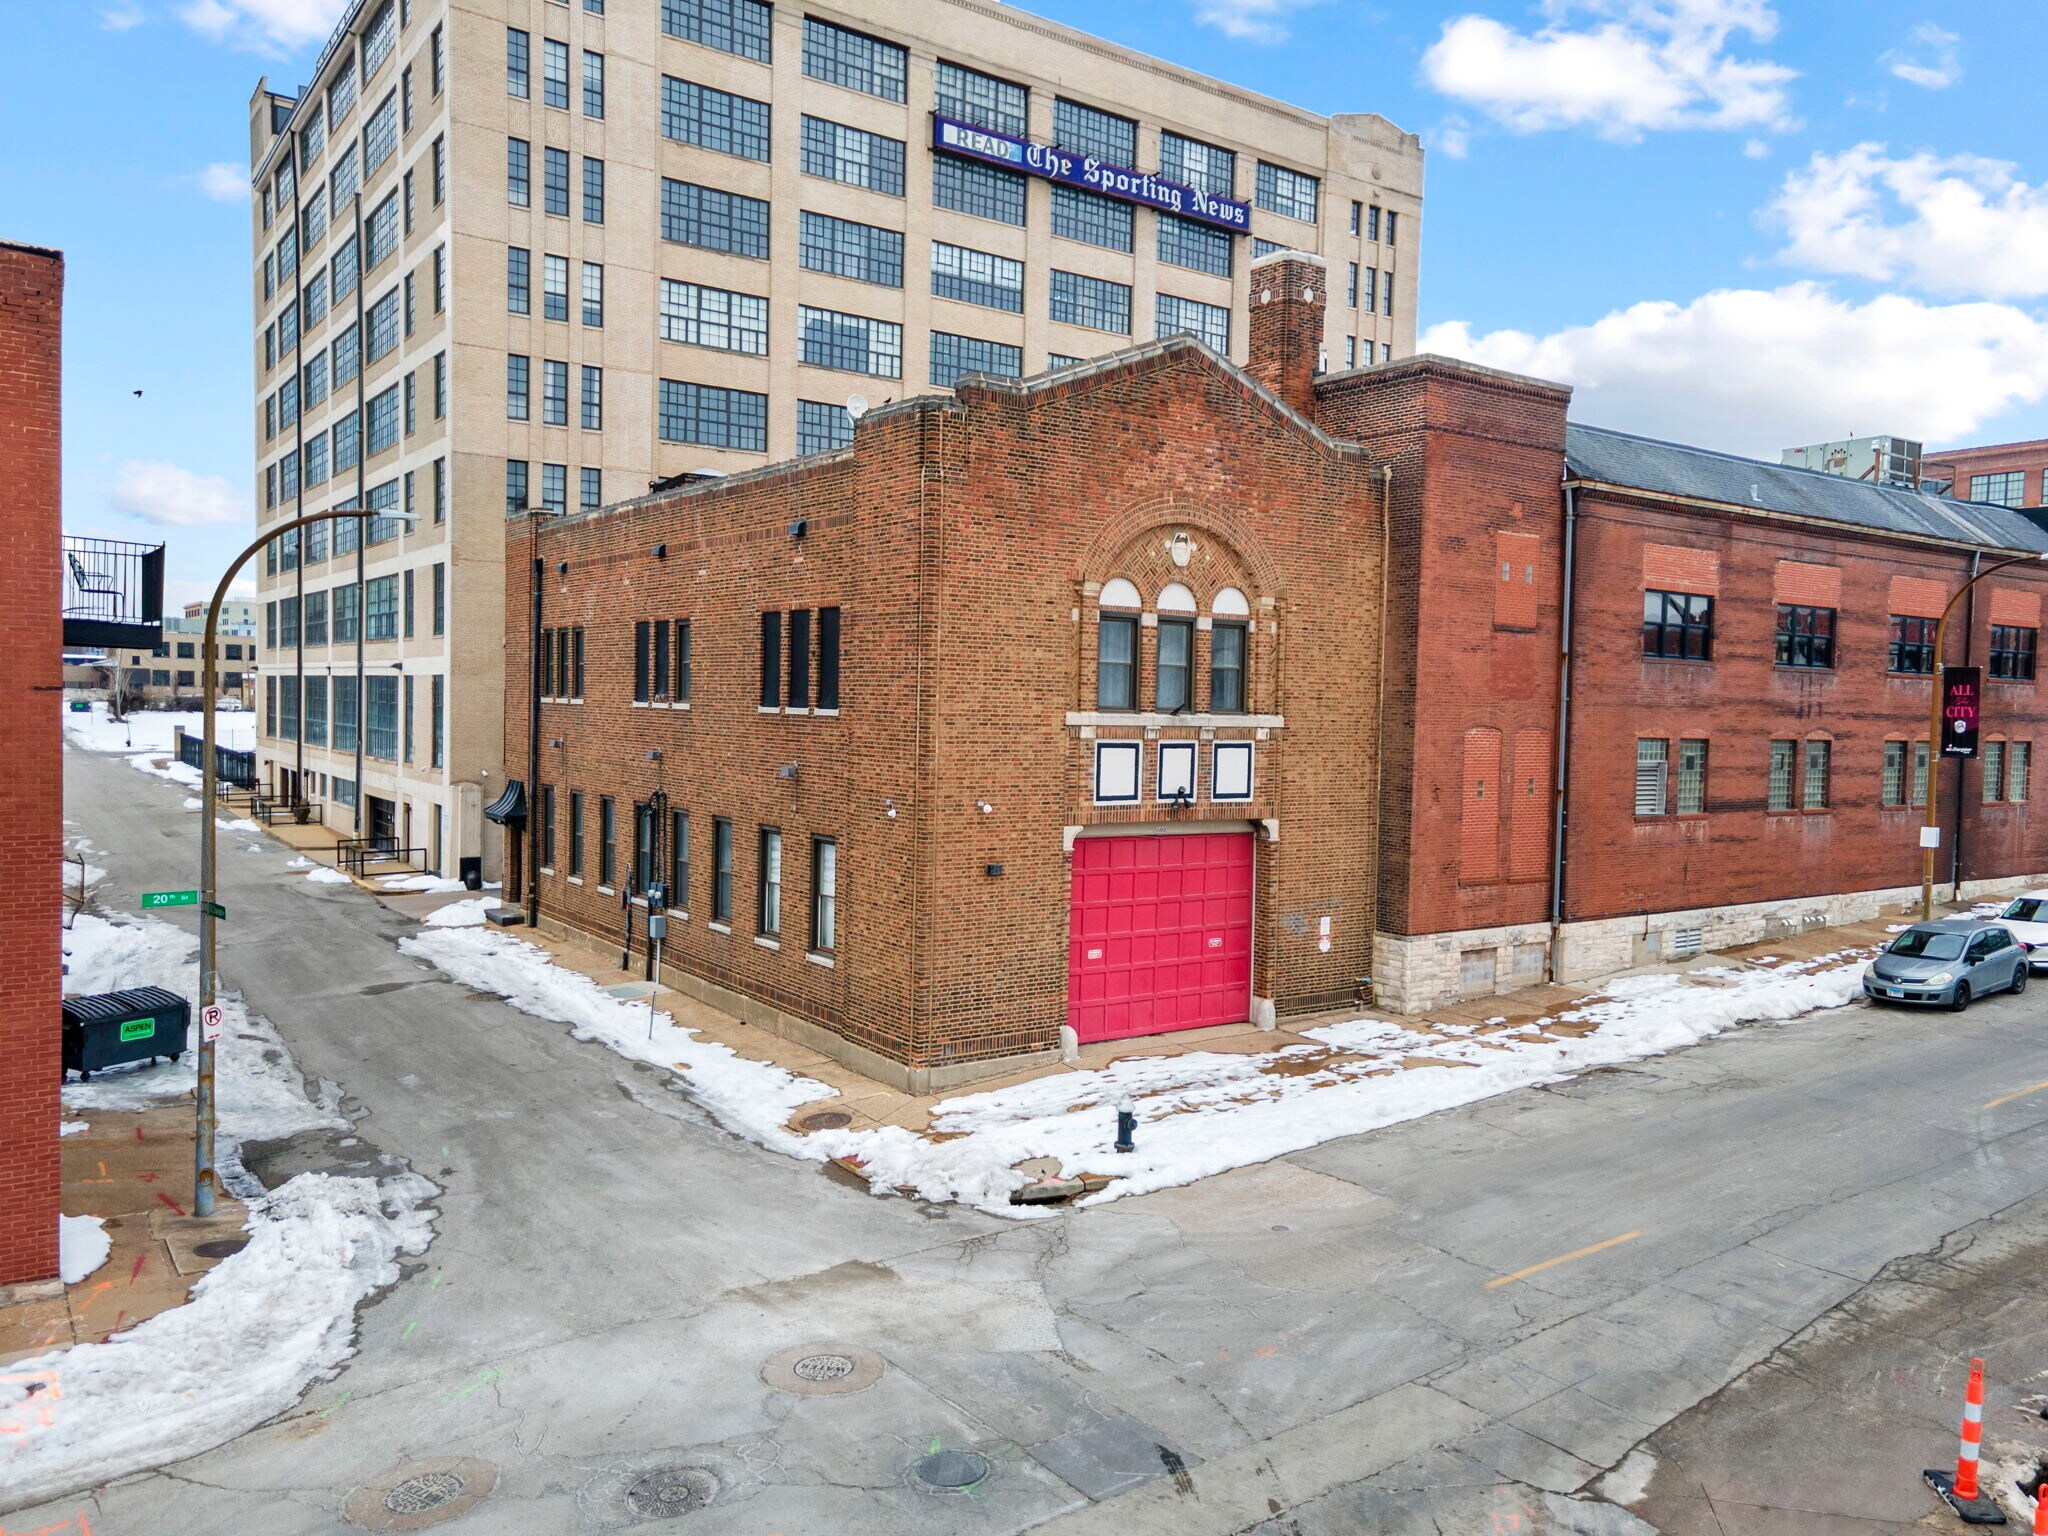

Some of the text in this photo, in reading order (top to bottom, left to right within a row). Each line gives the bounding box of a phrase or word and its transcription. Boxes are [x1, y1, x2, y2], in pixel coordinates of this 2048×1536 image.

[956, 127, 1245, 224] READ The Sporting News
[1950, 684, 1974, 696] ALL
[1946, 706, 1976, 718] CITY
[124, 1022, 152, 1033] ASPEN
